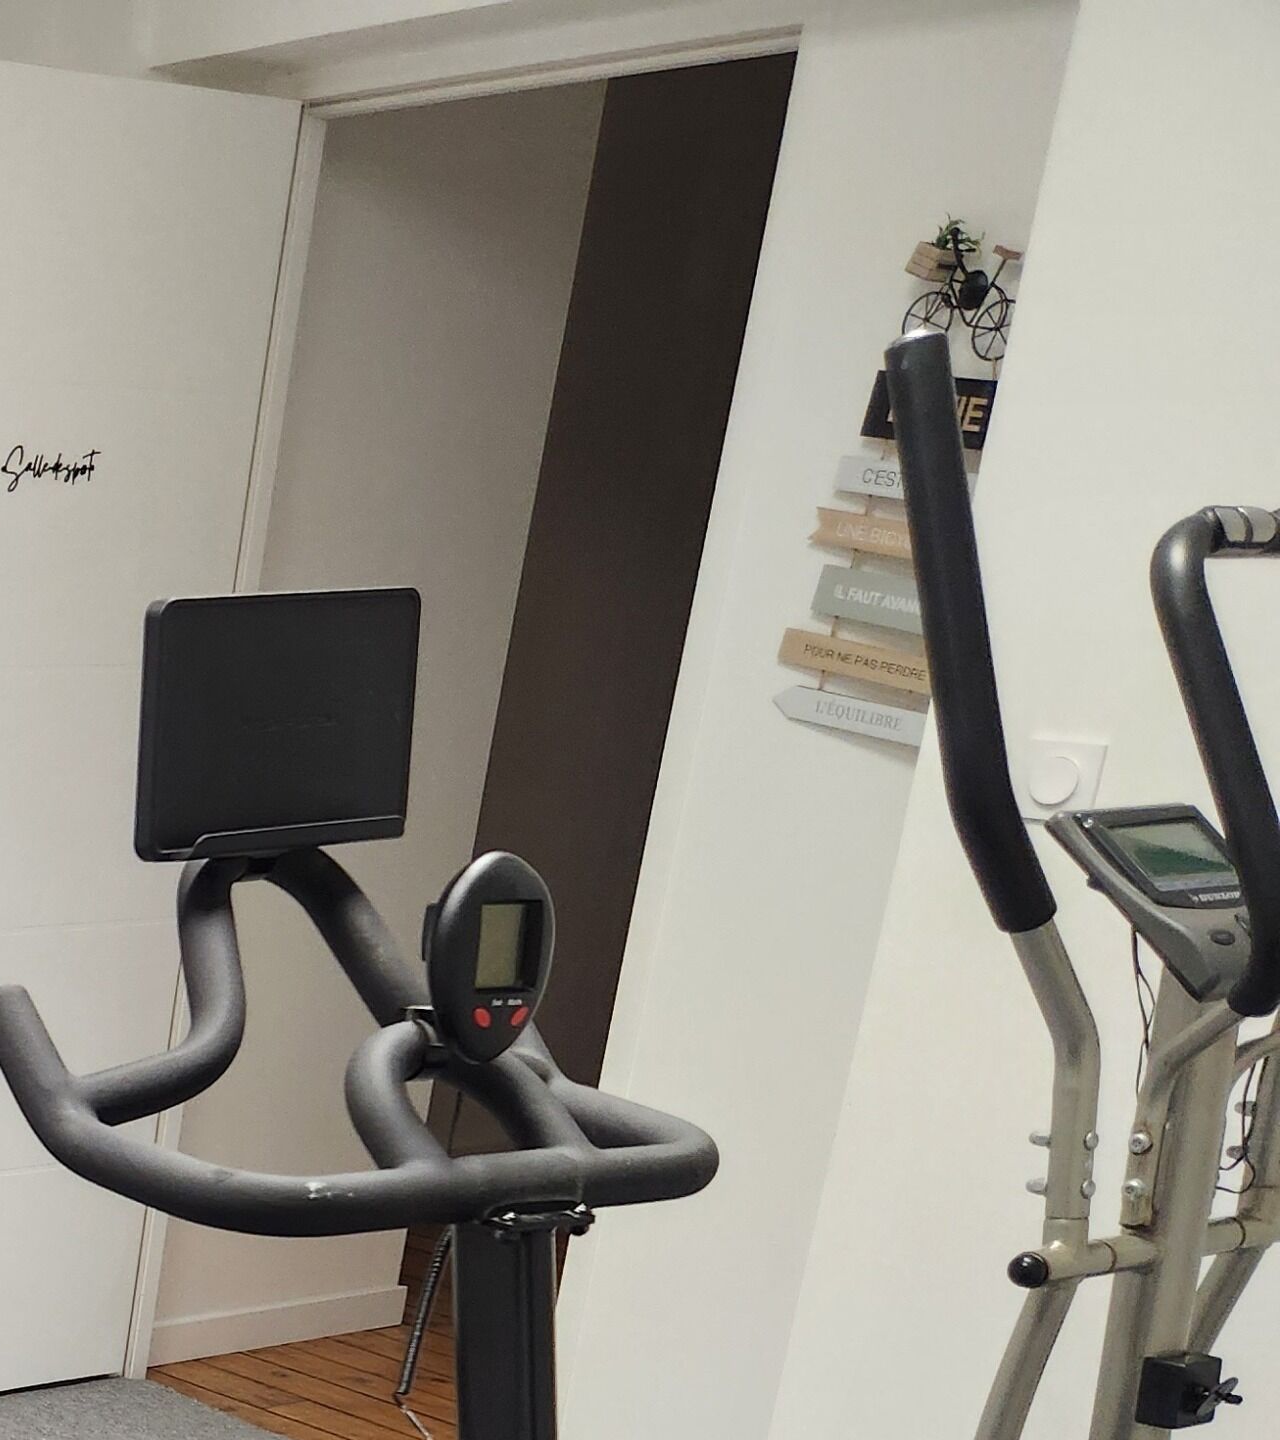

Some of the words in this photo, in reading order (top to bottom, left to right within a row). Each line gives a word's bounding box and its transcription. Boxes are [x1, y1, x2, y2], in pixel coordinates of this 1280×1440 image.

[846, 586, 881, 606] FAUT
[804, 643, 835, 660] POUR
[837, 651, 854, 665] NE
[854, 655, 879, 671] PAS
[879, 661, 927, 681] PERDRE
